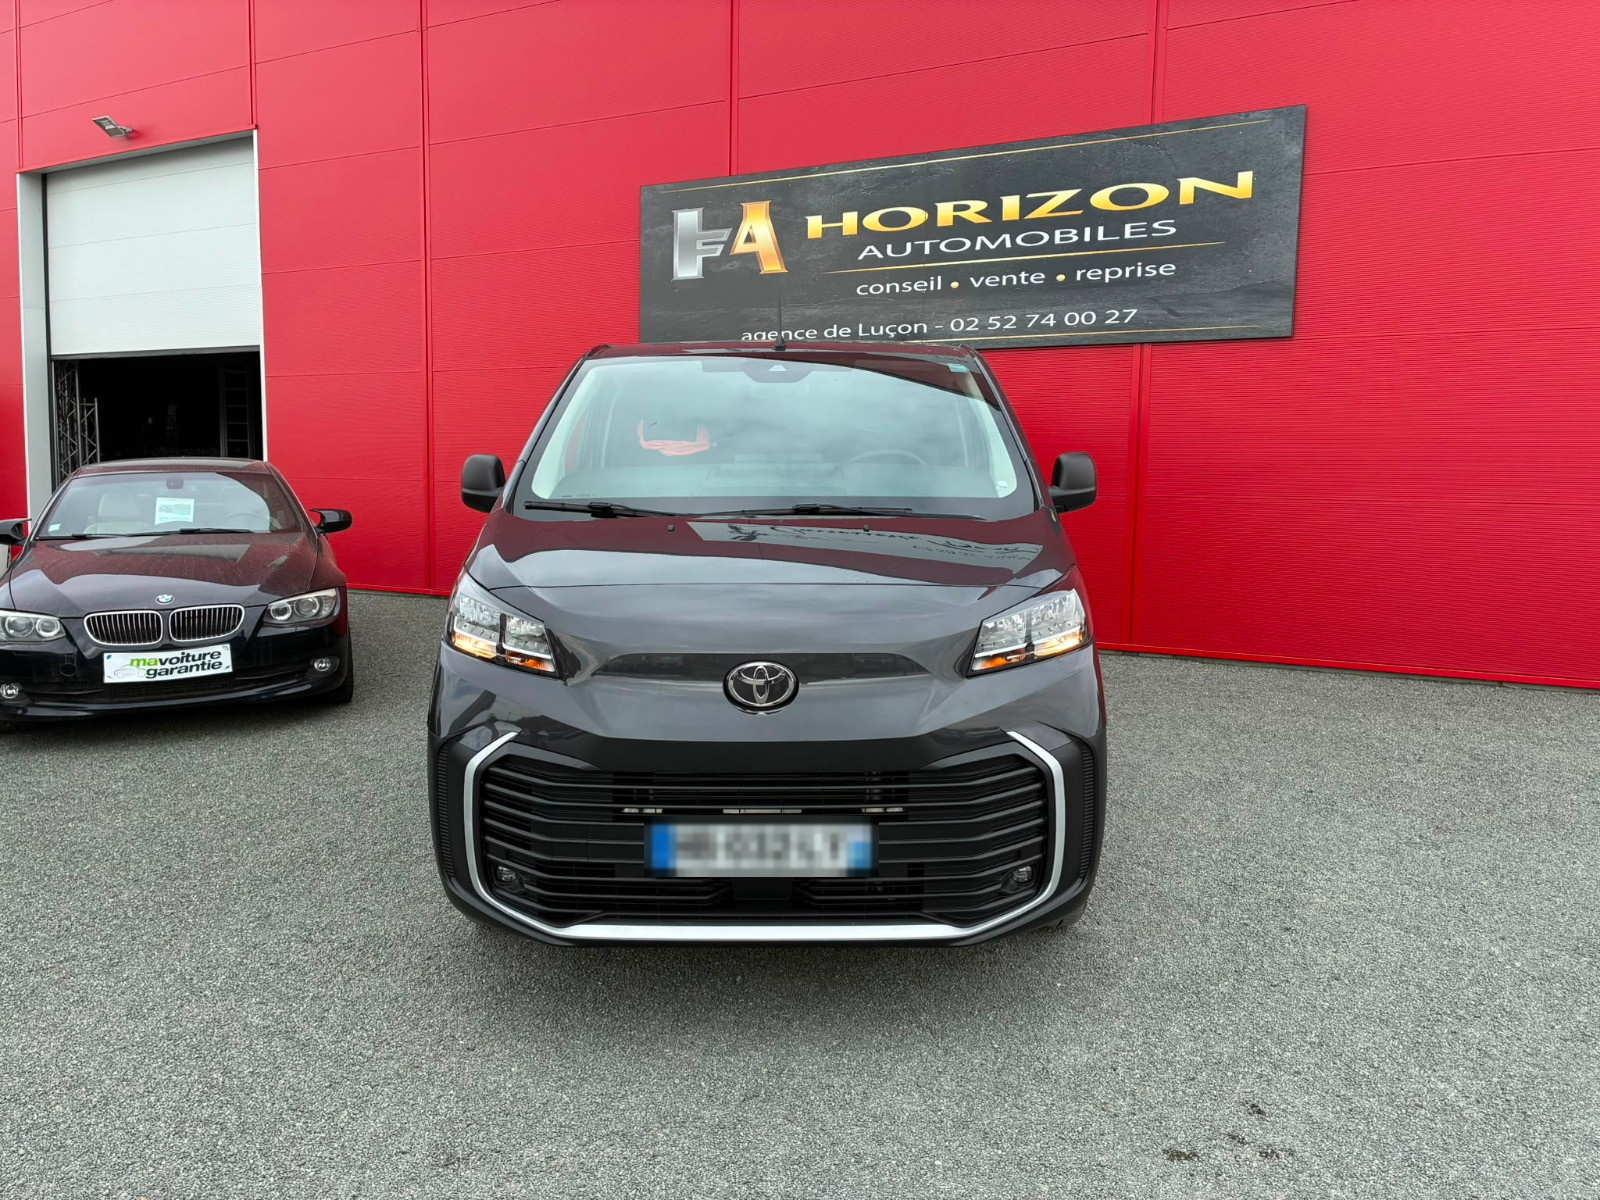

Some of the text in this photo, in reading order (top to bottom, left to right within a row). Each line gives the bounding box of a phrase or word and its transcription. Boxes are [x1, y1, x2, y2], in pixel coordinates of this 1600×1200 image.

[806, 171, 1254, 239] HORIZON
[857, 219, 1177, 260] AUTOMOBILES
[856, 262, 1177, 296] conseil vente reprise
[823, 324, 852, 338] de
[858, 322, 928, 338] Luçon
[950, 317, 980, 332] 02
[987, 315, 1017, 330] 52
[1026, 313, 1057, 328] 74
[1064, 311, 1097, 326] 00
[1104, 308, 1138, 325] 27
[129, 650, 222, 668] mavoiture
[145, 660, 223, 679] garantie
